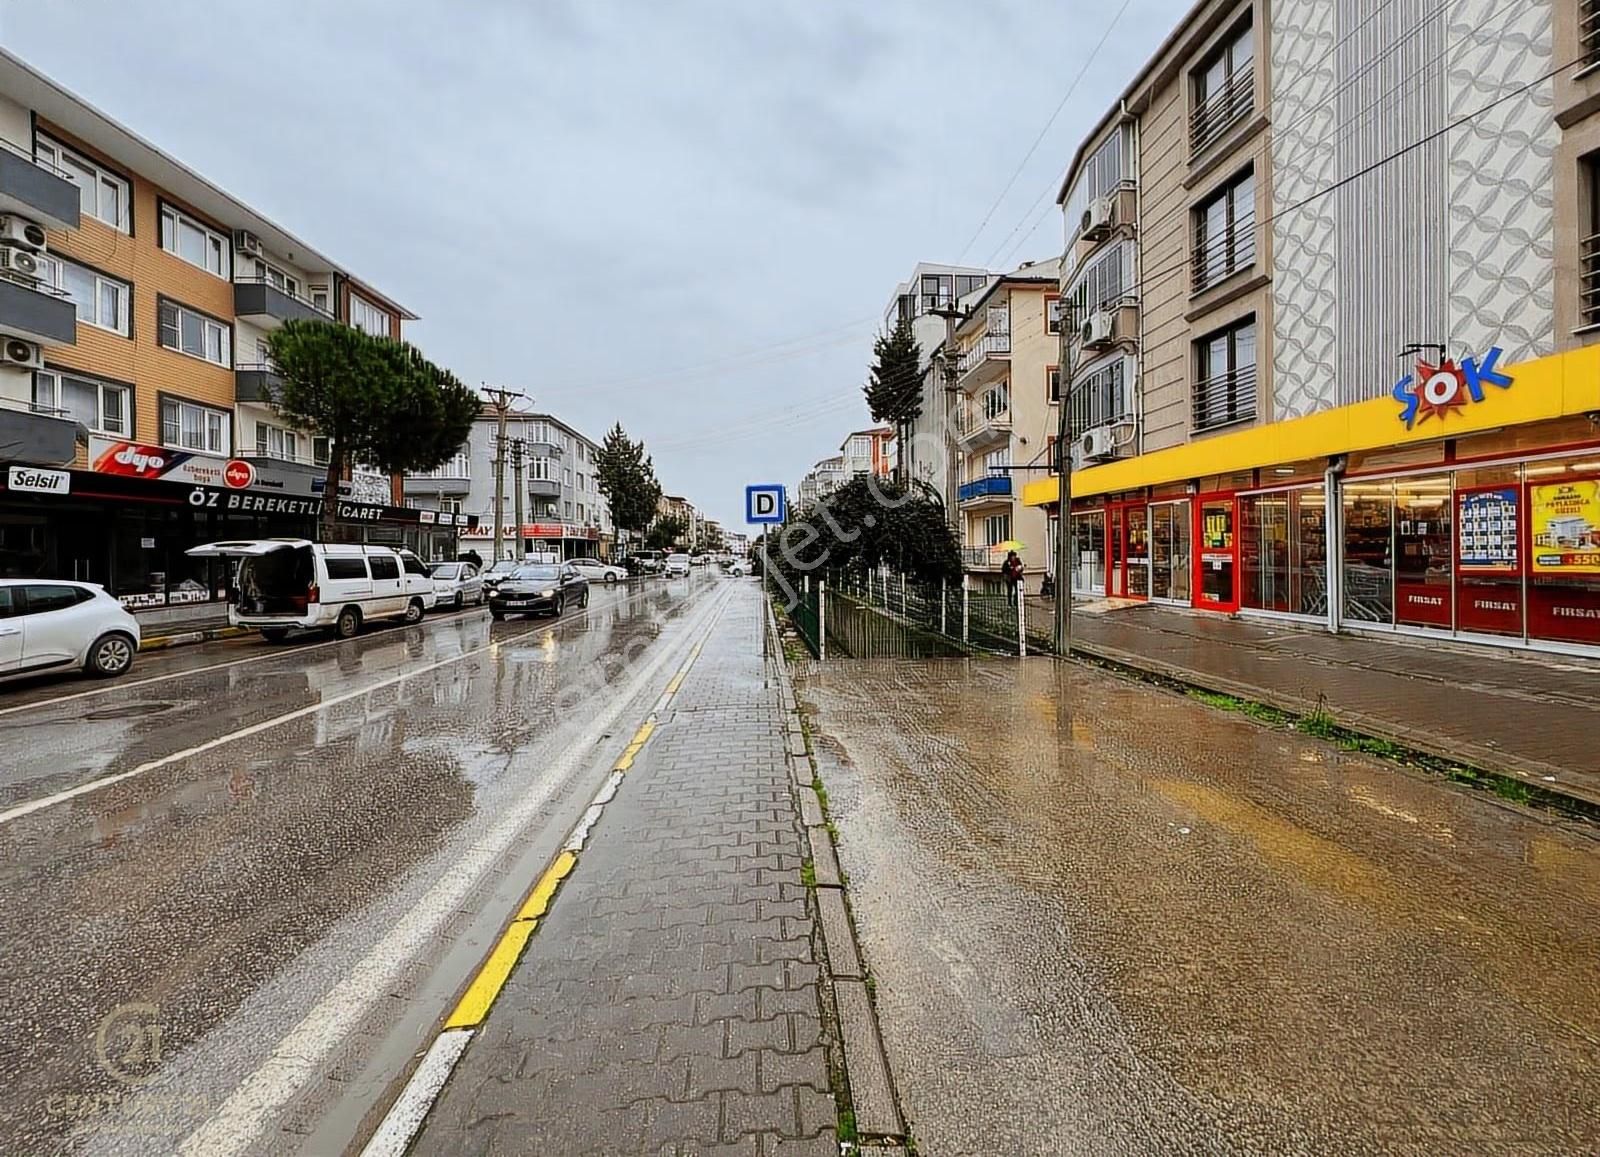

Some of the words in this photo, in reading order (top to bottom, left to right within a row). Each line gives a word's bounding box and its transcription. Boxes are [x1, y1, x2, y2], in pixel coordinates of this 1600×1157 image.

[114, 446, 165, 473] dyo
[14, 471, 60, 489] Selsil
[188, 486, 220, 507] ÖZ
[227, 494, 323, 515] BEREKETLİ
[336, 501, 384, 520] İCARET
[757, 494, 774, 514] D
[1408, 595, 1443, 606] FIRSAT
[1474, 600, 1517, 611] FIRSAT
